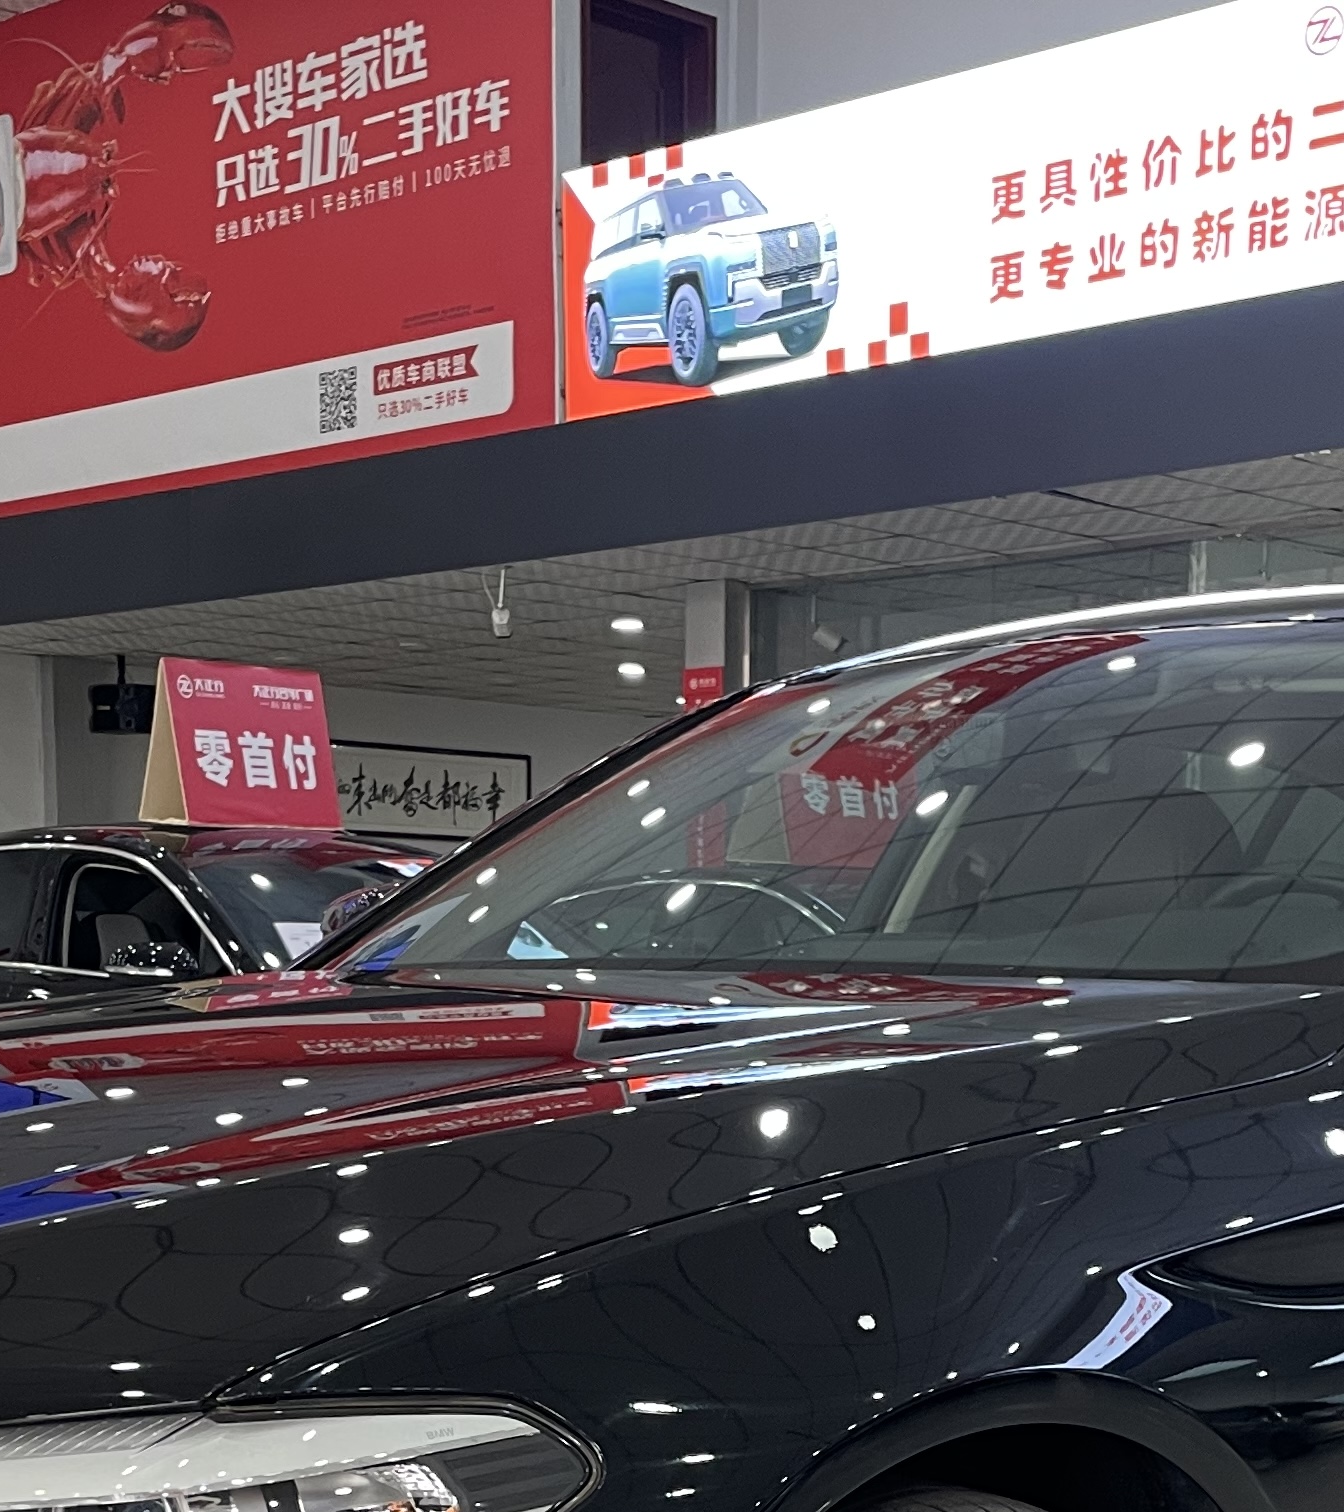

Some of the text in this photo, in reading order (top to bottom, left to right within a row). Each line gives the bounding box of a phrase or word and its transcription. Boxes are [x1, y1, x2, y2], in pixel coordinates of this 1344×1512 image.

[212, 20, 428, 142] 大搜车家选
[216, 79, 510, 208] 只选30%二手好车
[377, 353, 467, 391] 优质车商联盟
[194, 729, 317, 790] 零首付
[801, 772, 899, 820] 零首付
[426, 1427, 455, 1440] BMW
